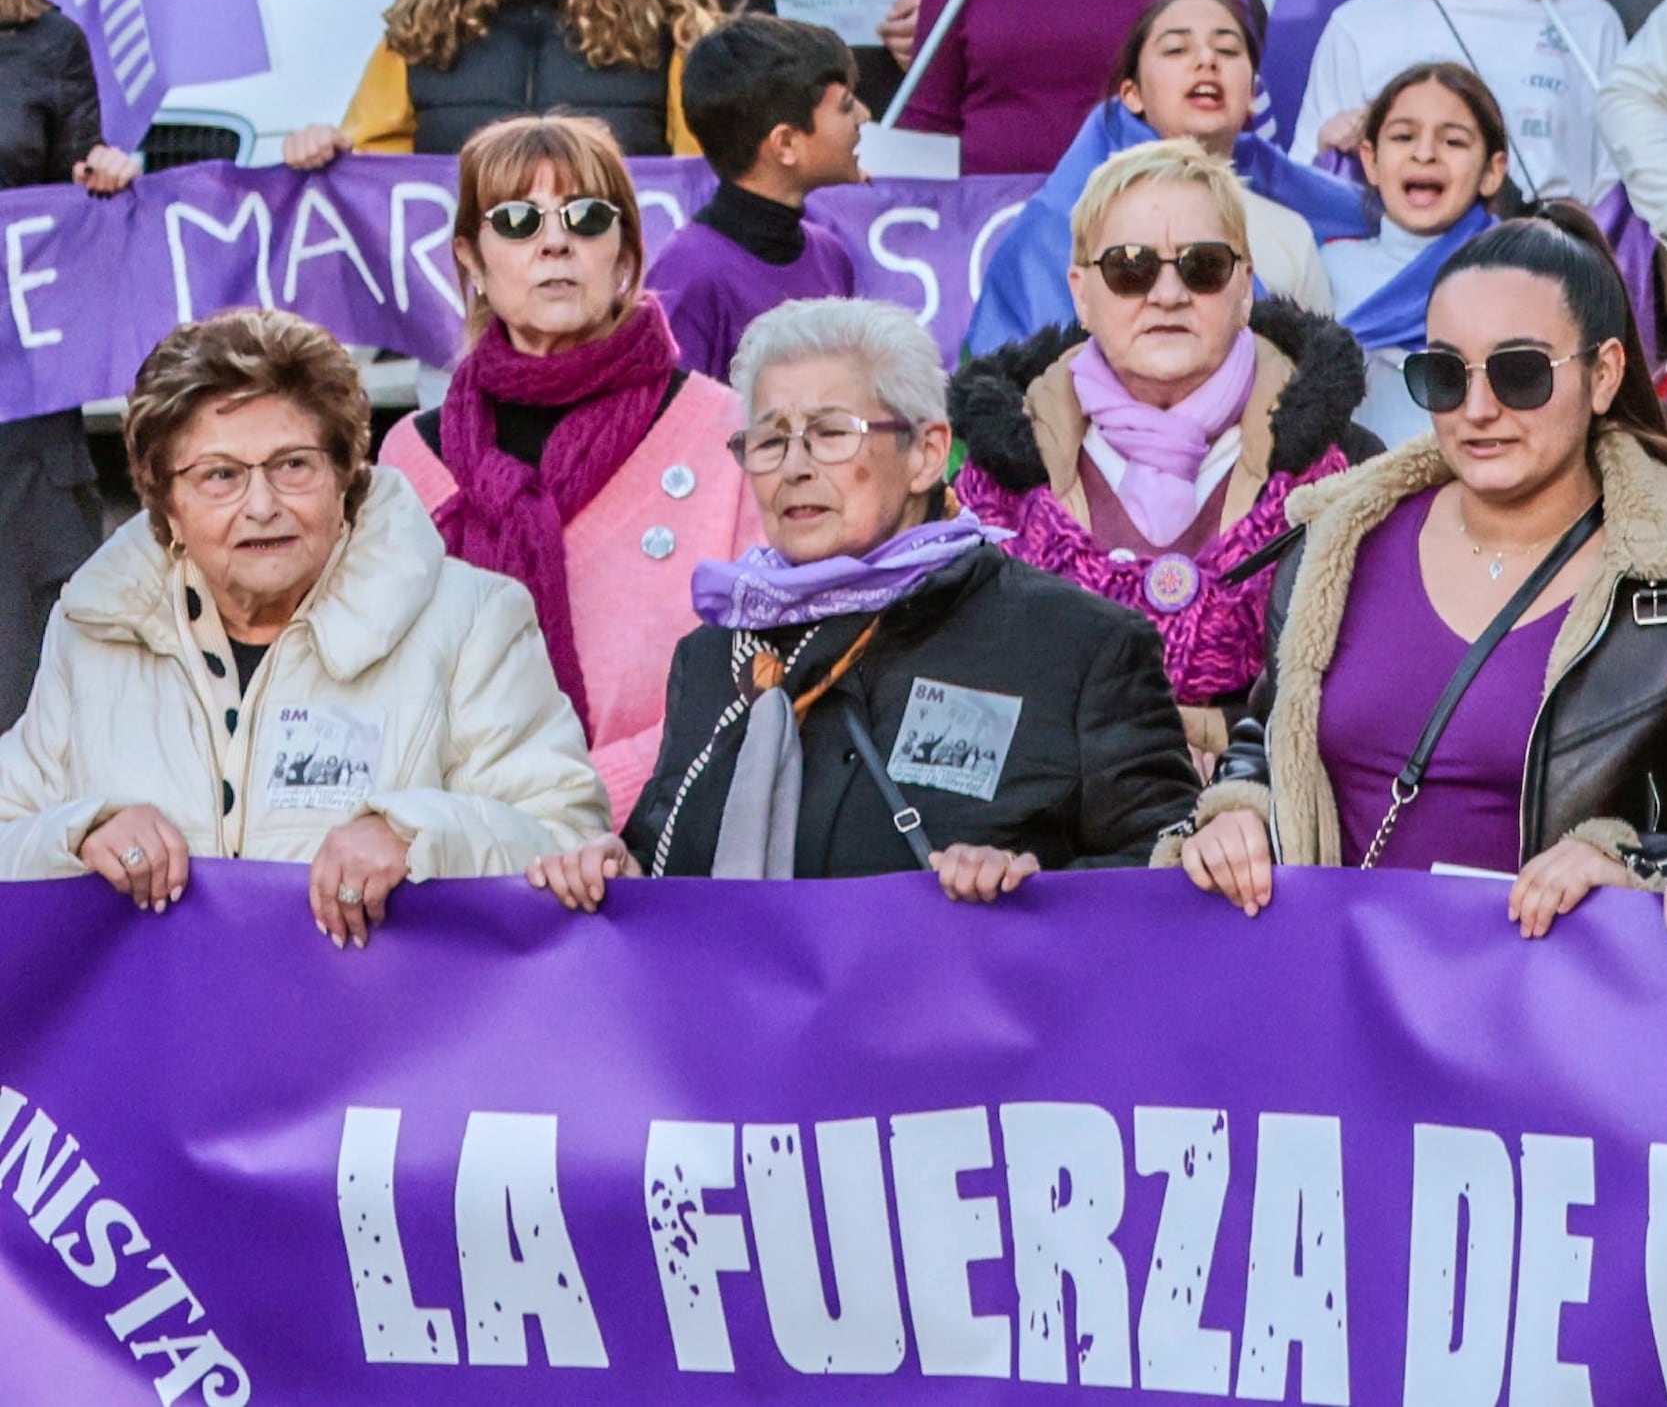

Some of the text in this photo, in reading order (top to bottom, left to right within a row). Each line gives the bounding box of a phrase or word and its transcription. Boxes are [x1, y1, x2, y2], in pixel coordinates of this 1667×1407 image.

[915, 684, 945, 704] 8M
[280, 709, 309, 723] 8M
[337, 1105, 609, 1370] LA
[643, 1100, 1350, 1402] FUERZA
[1407, 1122, 1597, 1407] DE
